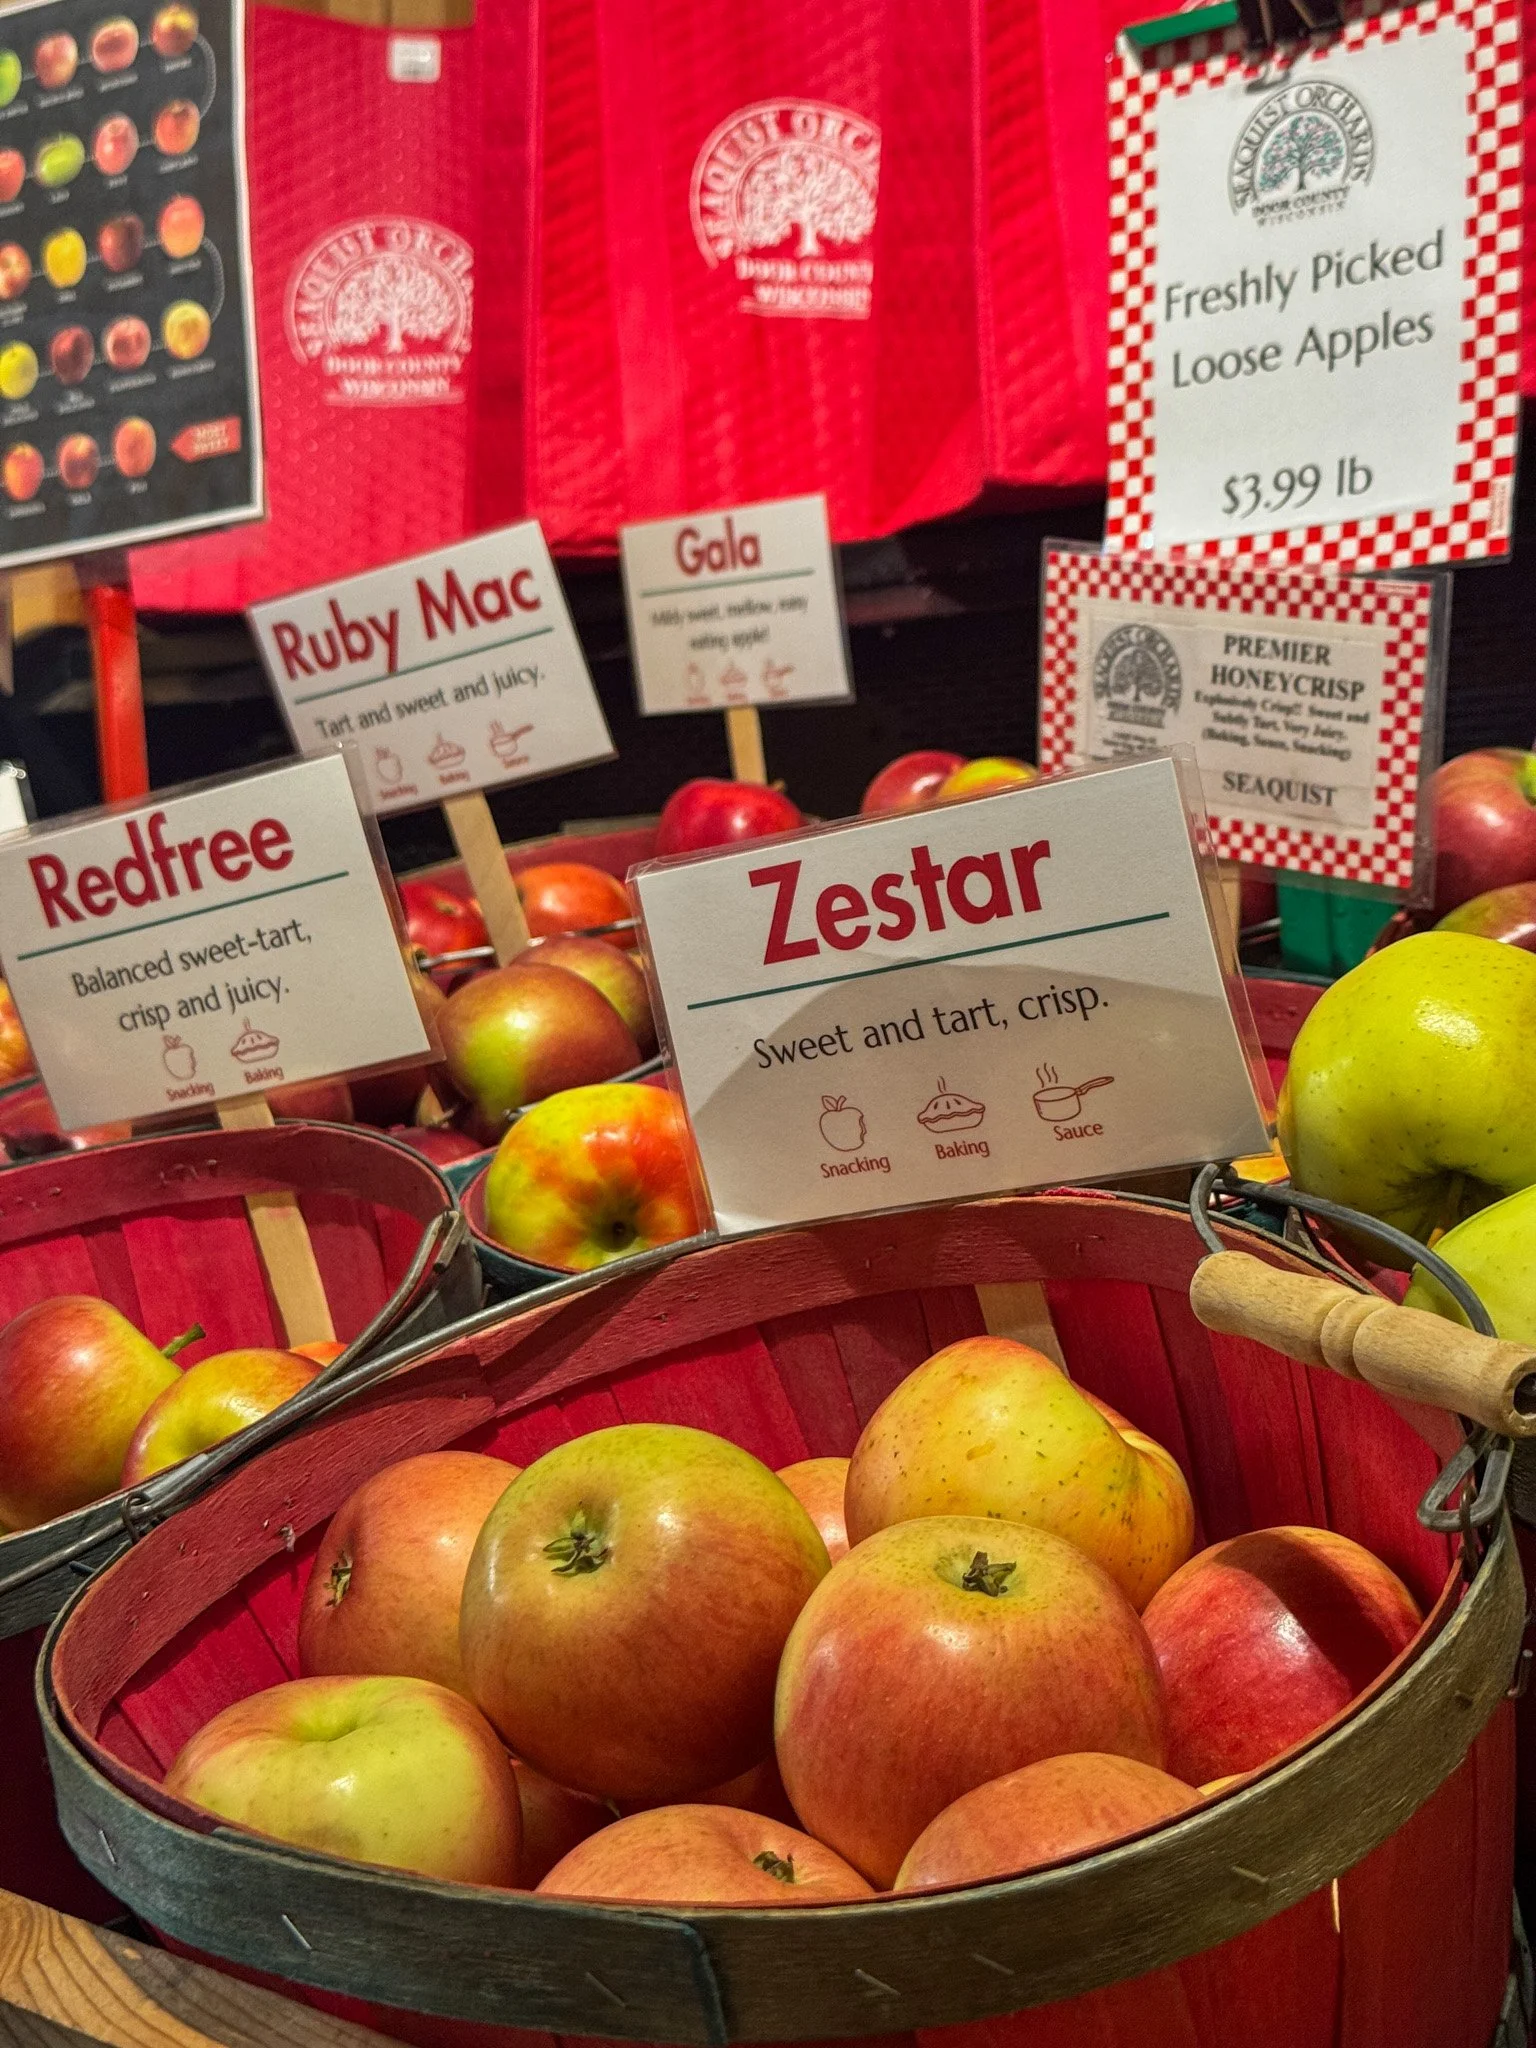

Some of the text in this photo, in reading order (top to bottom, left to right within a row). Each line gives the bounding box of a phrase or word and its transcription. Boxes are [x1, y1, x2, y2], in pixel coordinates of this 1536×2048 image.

[1232, 93, 1290, 209] SEAQUIST
[1165, 227, 1443, 322] Freshly Picked
[1173, 307, 1435, 389] Loose Apples
[1222, 456, 1373, 519] $3.99 lb
[675, 515, 761, 576] Gala
[271, 567, 542, 681] Ruby Mac
[1224, 633, 1331, 667] PREMIER
[314, 663, 546, 740] Tart and sweet and juicy.
[1210, 663, 1366, 702] HONEYCRISP
[1222, 770, 1338, 807] SEAQUIST
[27, 810, 295, 930] Redfree
[747, 840, 1052, 966] Zestar
[71, 918, 313, 999] Balanced sweet-tart,
[119, 975, 290, 1035] crisp and juicy.
[753, 985, 1110, 1069] Sweet and tart, crisp.
[165, 1081, 216, 1101] Snacking
[243, 1064, 285, 1085] Baking
[934, 1141, 991, 1161] Baking
[1053, 1121, 1104, 1142] Sauce
[820, 1155, 892, 1180] Snacking
